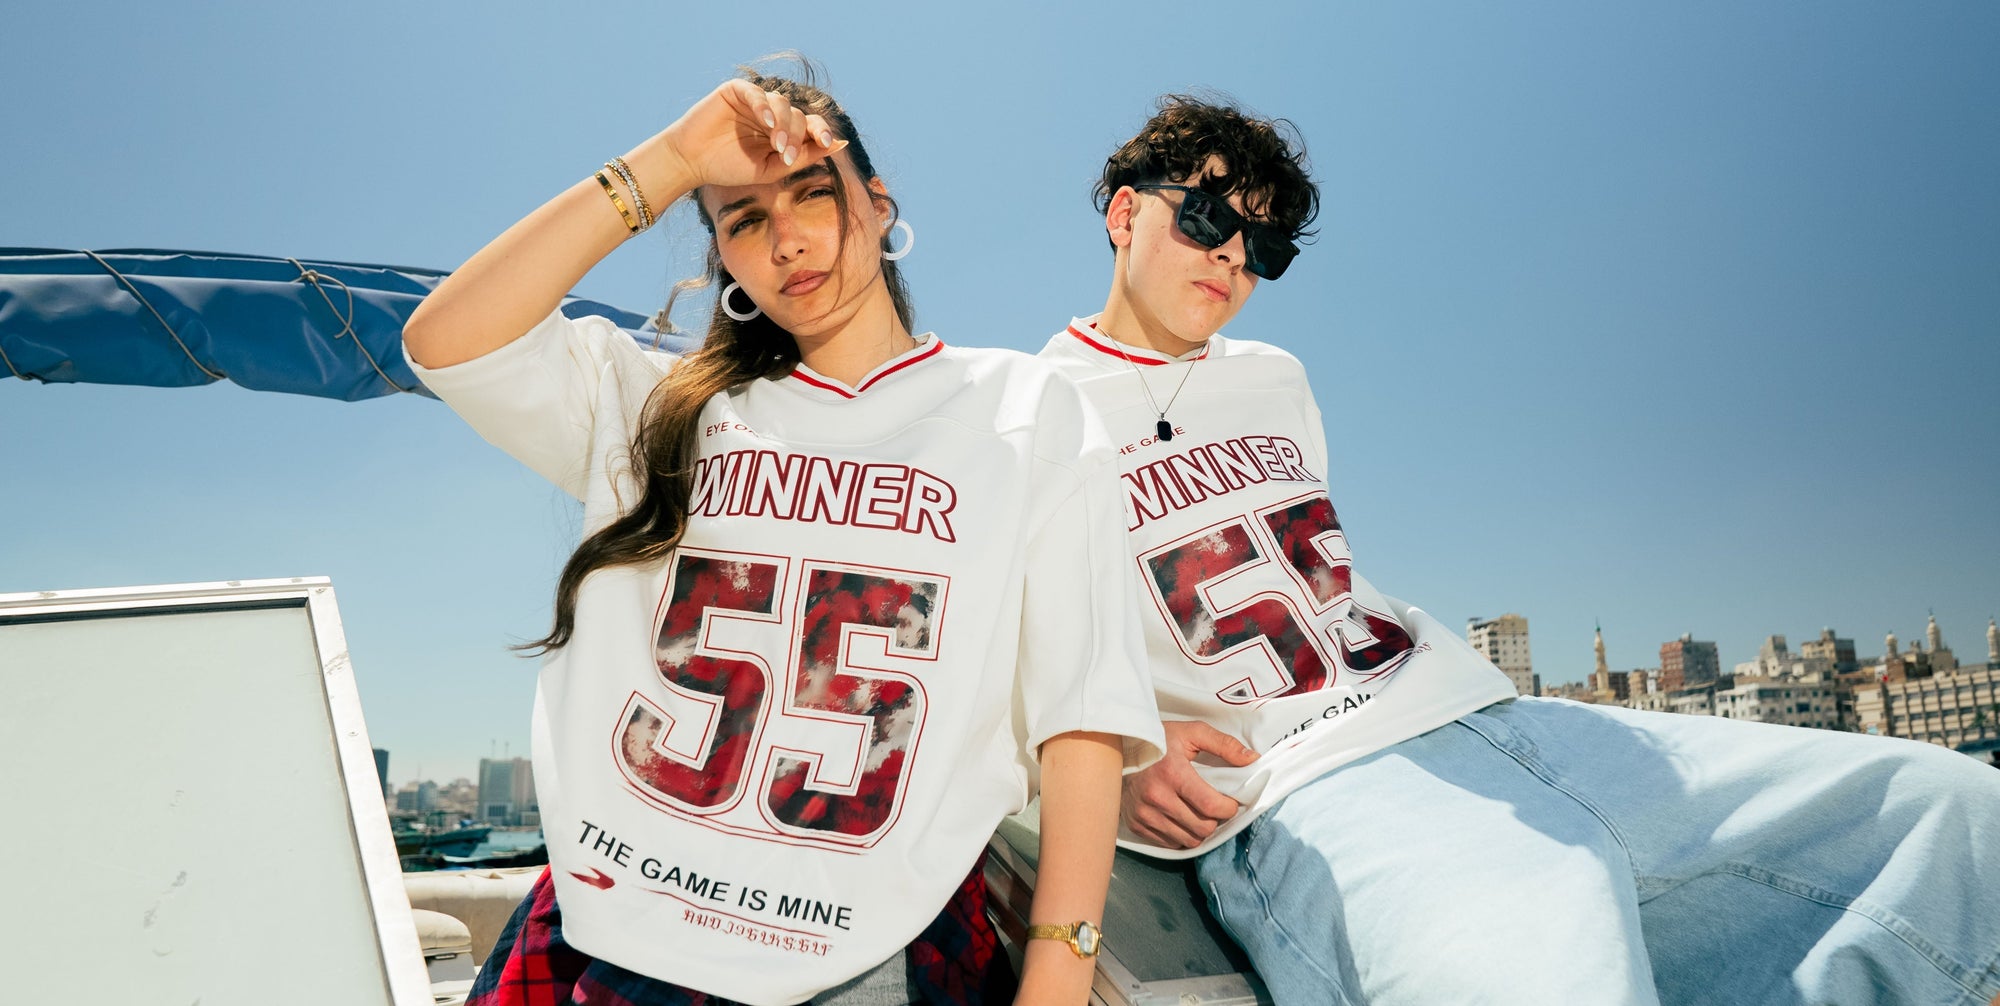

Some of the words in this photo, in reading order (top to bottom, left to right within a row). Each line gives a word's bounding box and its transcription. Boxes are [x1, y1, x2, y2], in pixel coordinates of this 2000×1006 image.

[705, 421, 729, 437] EYE
[687, 450, 957, 543] WINNER
[612, 545, 950, 849] 55
[578, 820, 634, 868] THE
[640, 858, 730, 902] GAME
[738, 886, 767, 912] IS
[776, 895, 852, 931] MINE
